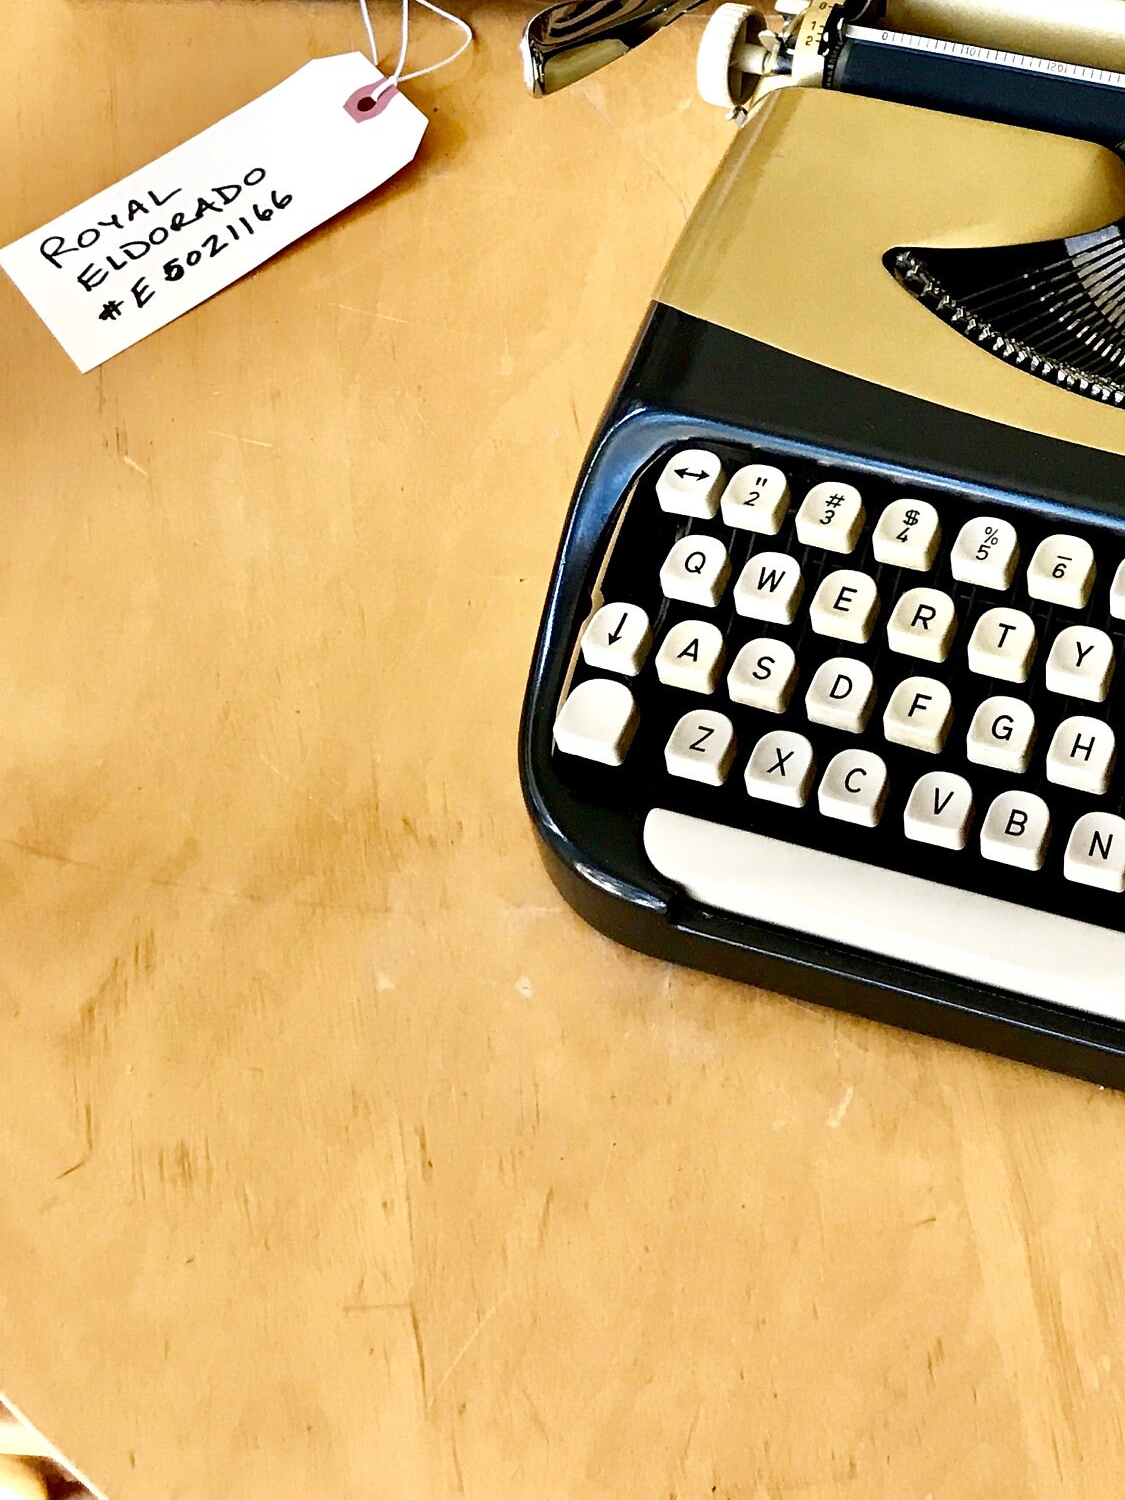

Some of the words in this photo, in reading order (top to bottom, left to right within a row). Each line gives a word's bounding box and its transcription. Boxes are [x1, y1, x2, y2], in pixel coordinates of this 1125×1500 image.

[805, 36, 813, 45] 2
[40, 188, 182, 268] ROYAL
[77, 168, 266, 291] ELDORADO
[743, 492, 759, 506] 2
[820, 510, 834, 524] 3
[896, 528, 910, 542] 4
[976, 545, 991, 560] 5
[1052, 563, 1066, 578] 6
[826, 494, 845, 508] #
[903, 510, 920, 526] $
[984, 527, 998, 545] %
[685, 552, 706, 574] Q
[757, 567, 786, 592] W
[833, 587, 857, 611] E
[911, 604, 936, 629] R
[998, 623, 1016, 648] T
[1076, 642, 1094, 667] Y
[677, 639, 698, 662] A
[753, 656, 775, 680] S
[829, 674, 852, 699] D
[908, 693, 932, 717] F
[992, 715, 1014, 741] G
[1070, 733, 1095, 761] H
[689, 726, 714, 752] Z
[766, 748, 794, 776] X
[845, 768, 866, 793] C
[934, 788, 954, 814] V
[1005, 809, 1027, 836] B
[1089, 831, 1113, 859] N
